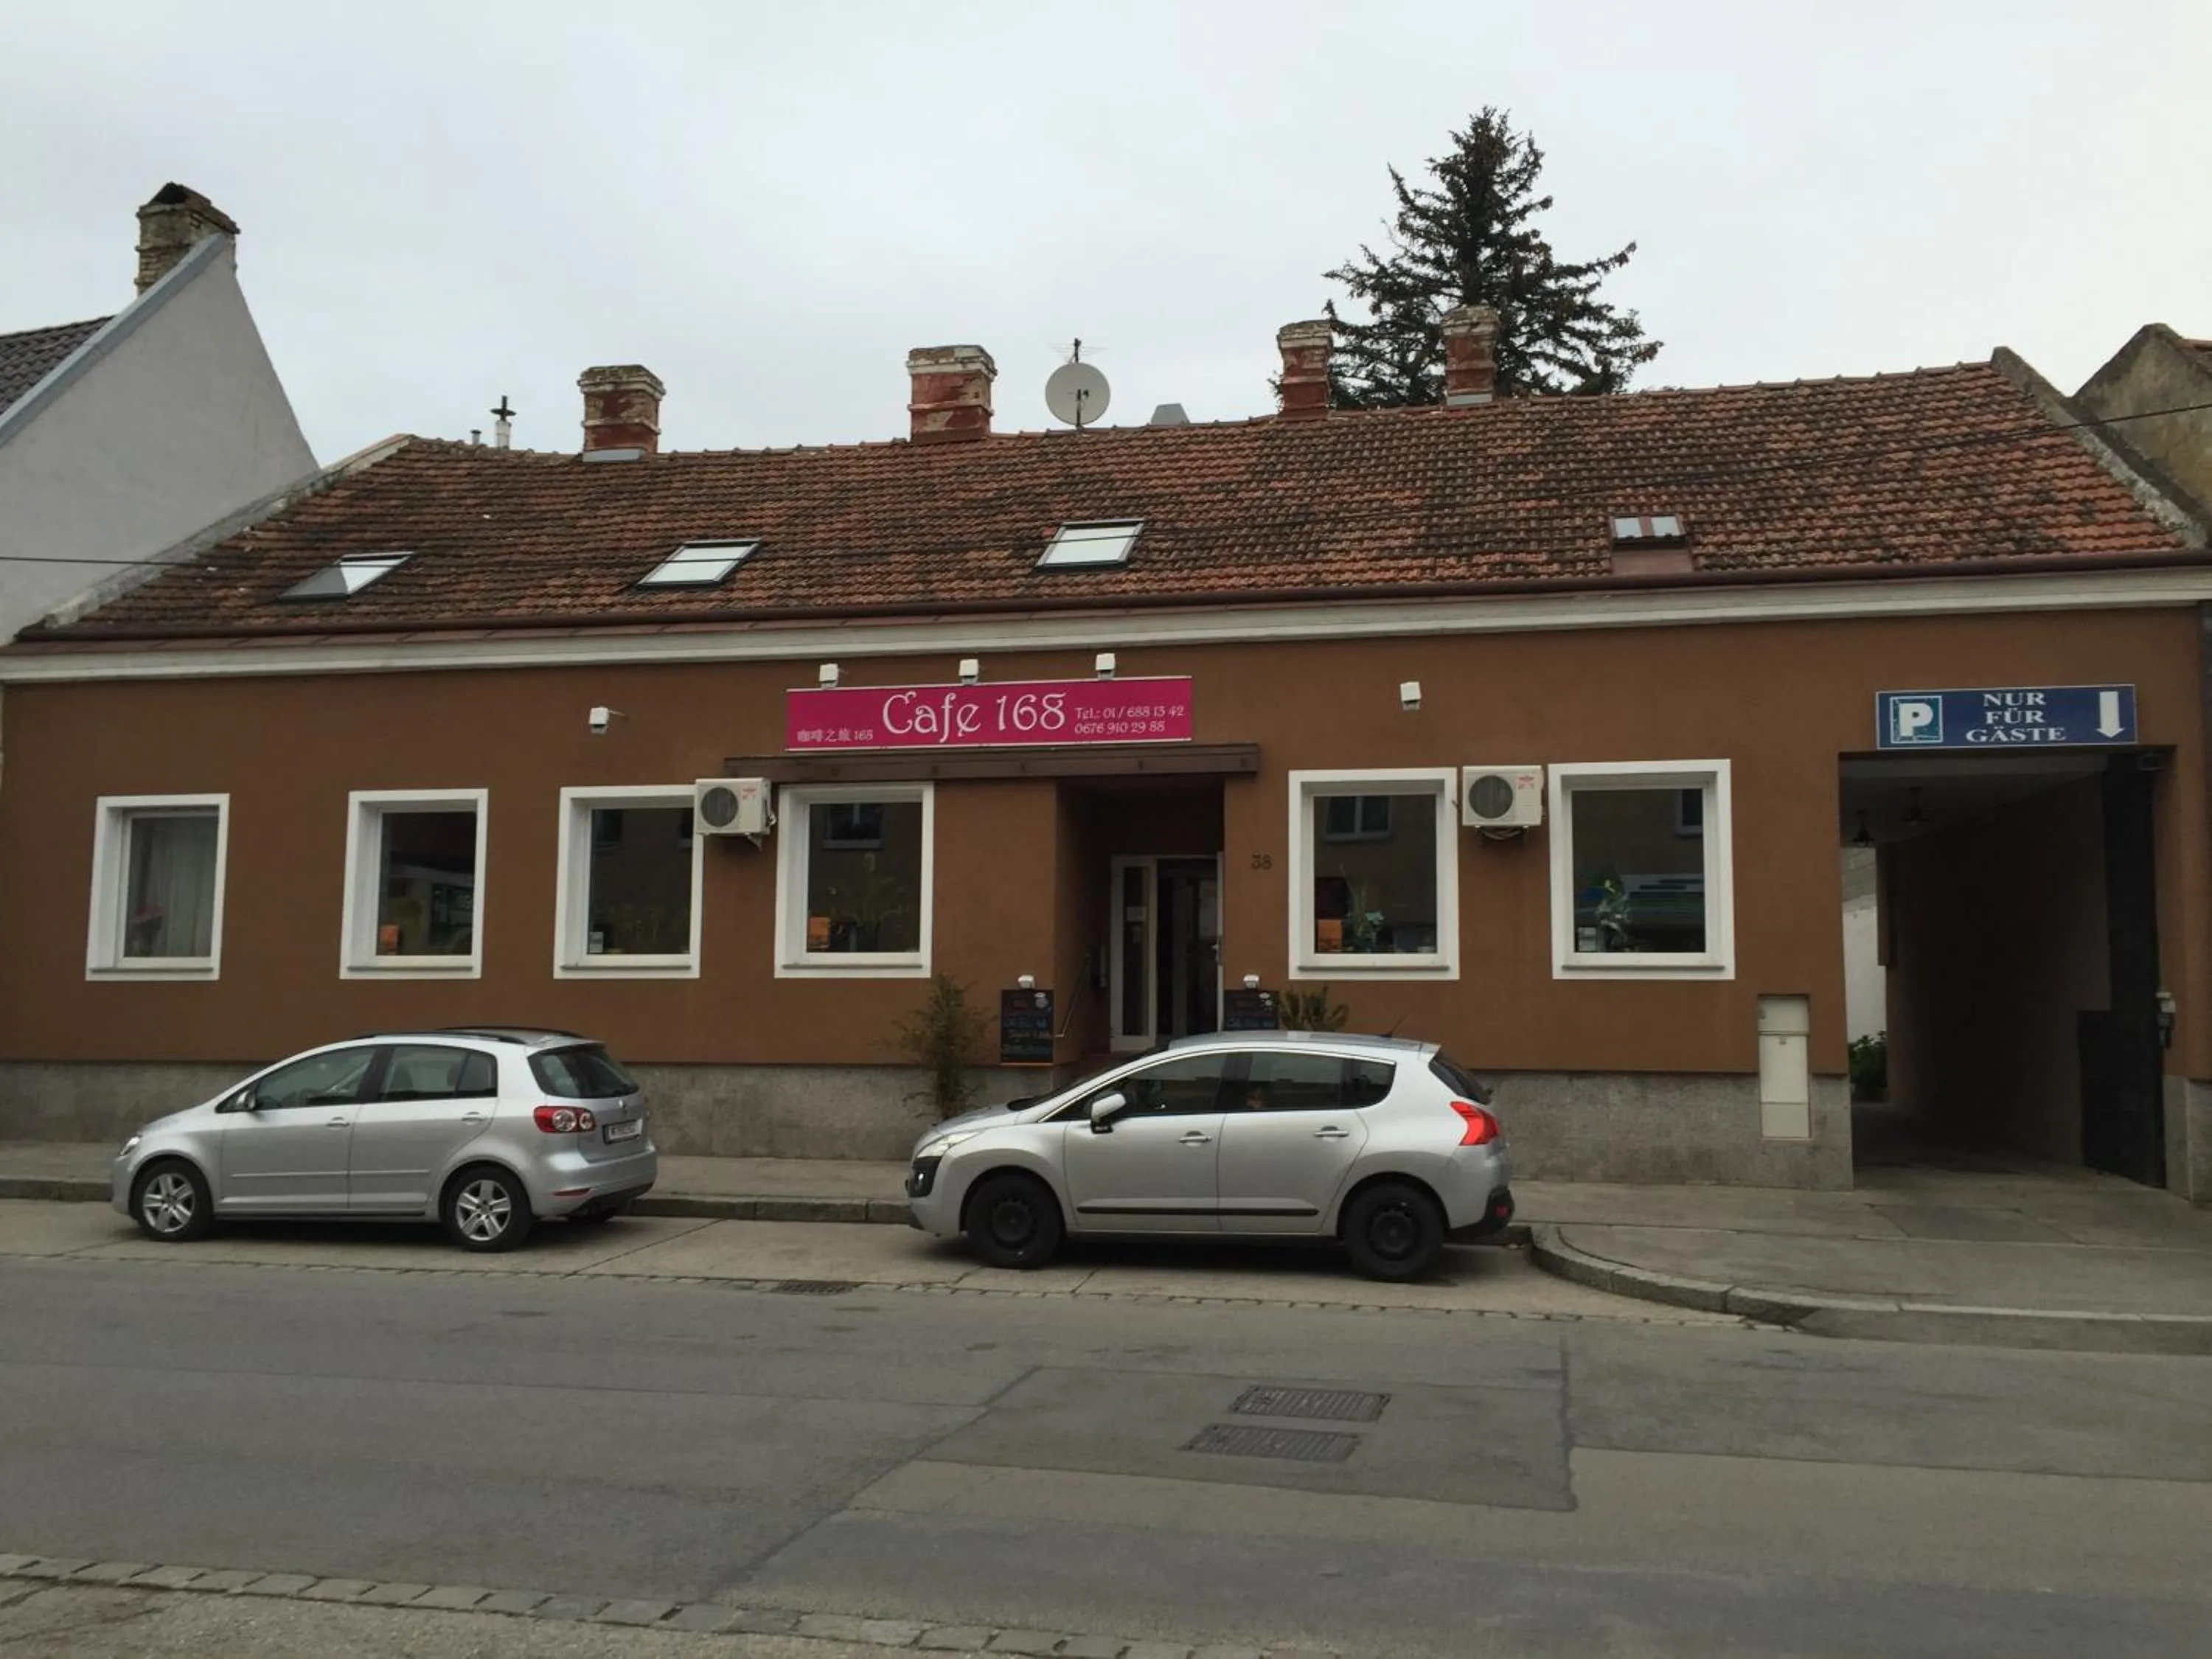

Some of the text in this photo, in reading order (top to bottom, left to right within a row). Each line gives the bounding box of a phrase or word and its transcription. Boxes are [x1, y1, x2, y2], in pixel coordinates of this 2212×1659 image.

[1983, 692, 2048, 707] NUR
[883, 691, 1067, 743] Cafe 168
[1127, 705, 1151, 718] 688
[1168, 704, 1185, 717] 42
[1985, 707, 2045, 725] FÜR
[1074, 723, 1105, 735] 0676
[1105, 722, 1128, 735] 910
[1130, 720, 1147, 734] 29
[1899, 703, 1933, 737] P
[1965, 726, 2067, 743] GÄSTE
